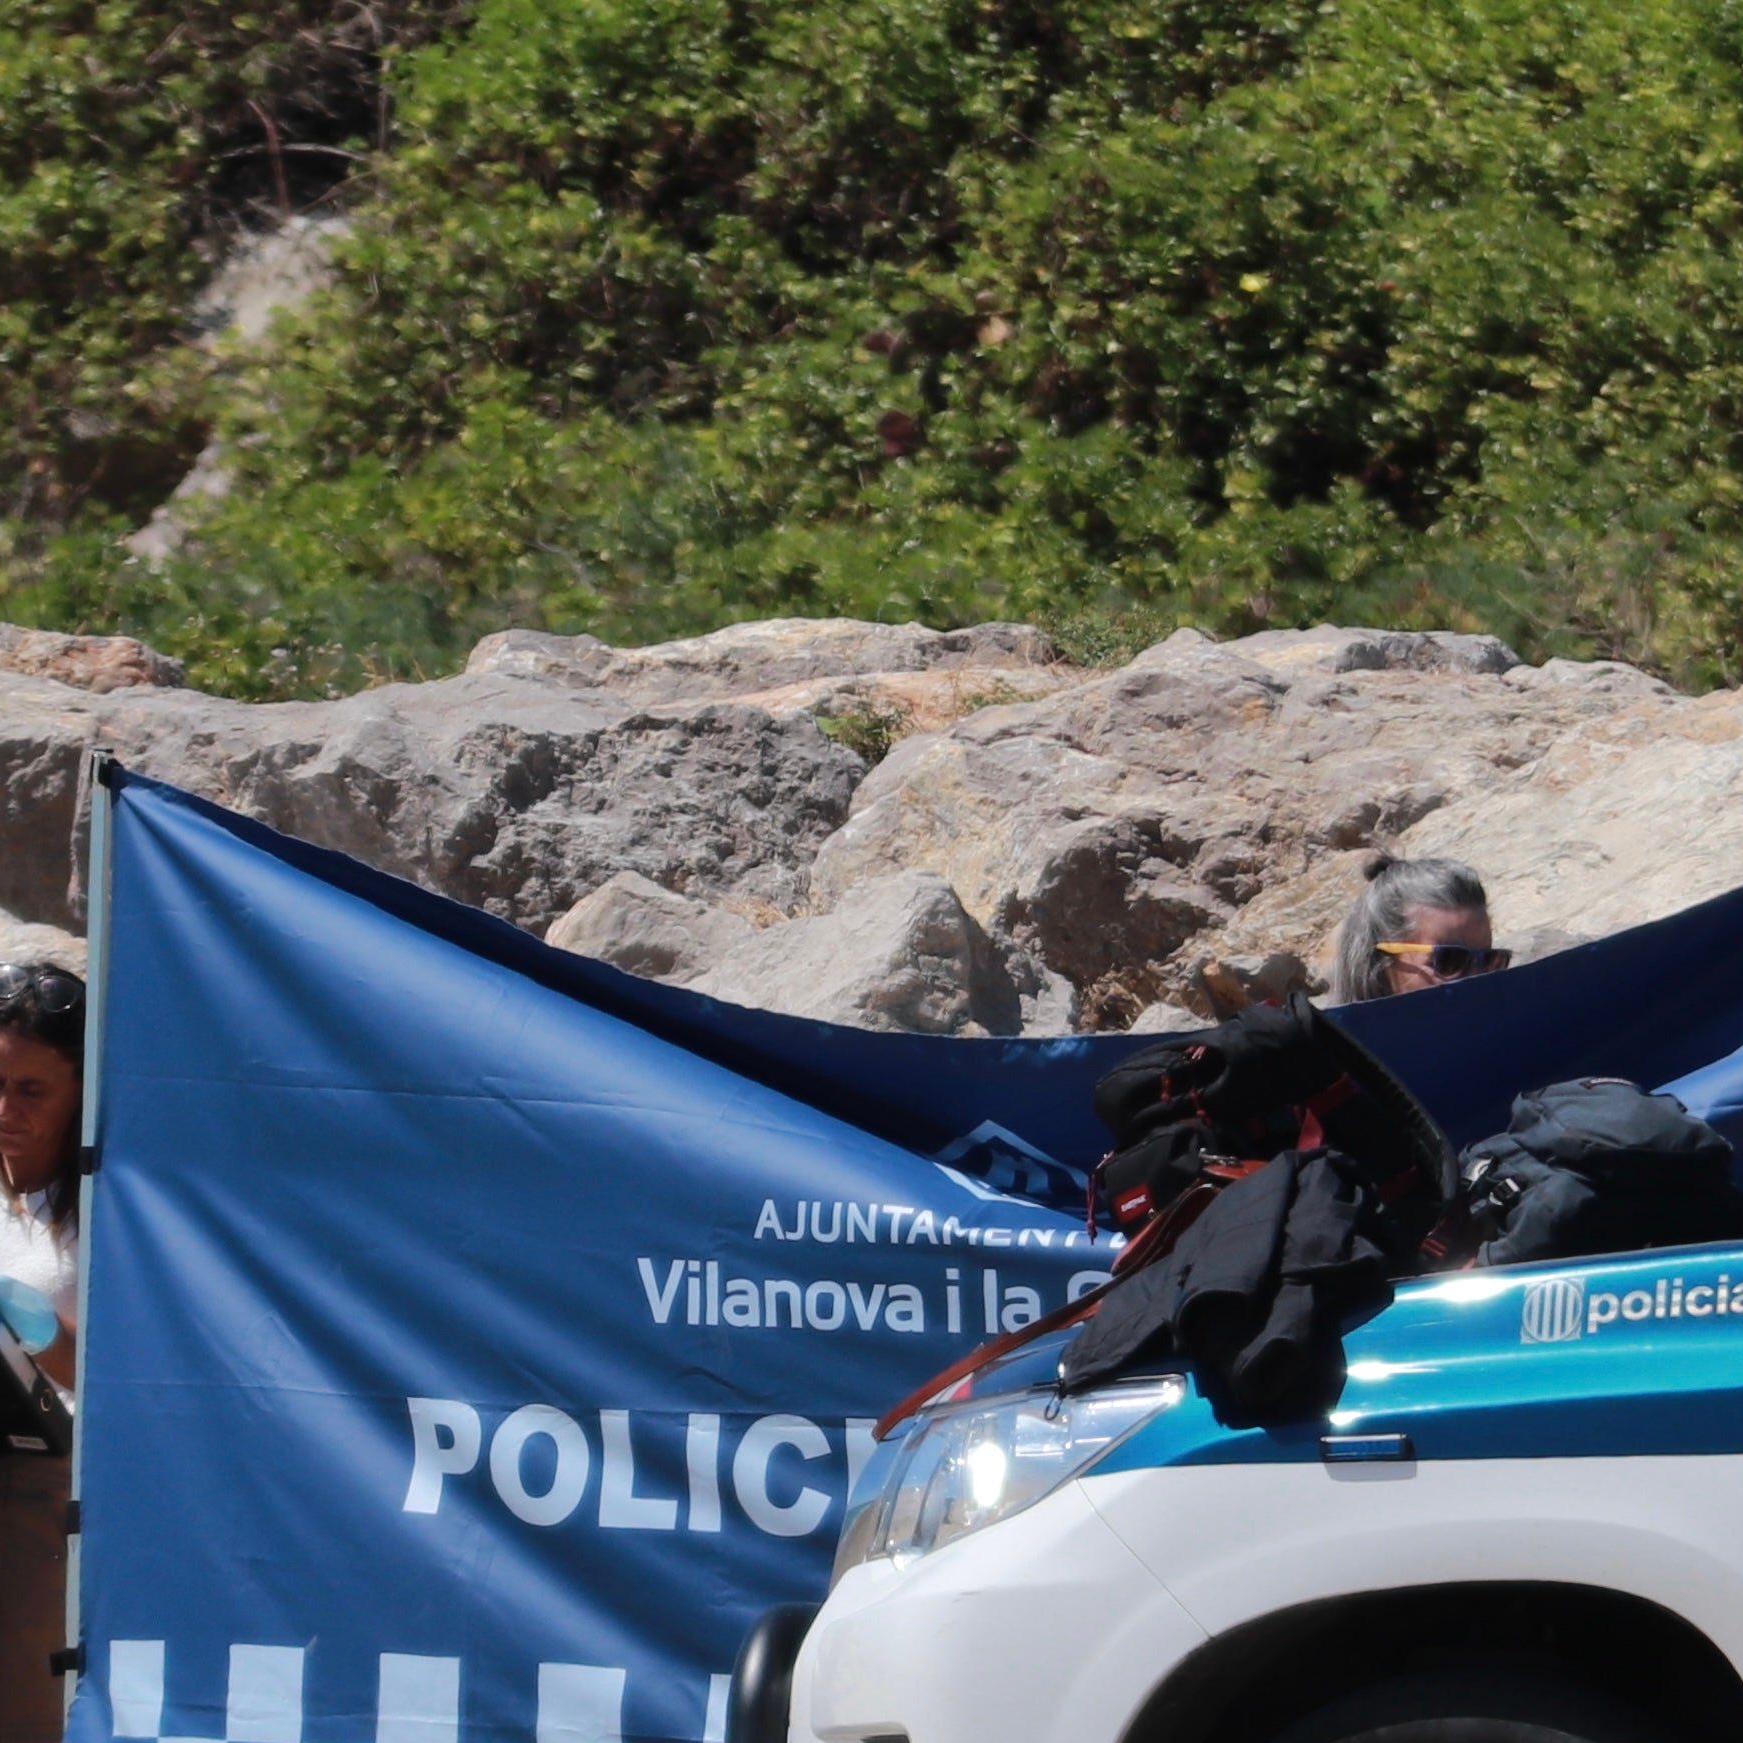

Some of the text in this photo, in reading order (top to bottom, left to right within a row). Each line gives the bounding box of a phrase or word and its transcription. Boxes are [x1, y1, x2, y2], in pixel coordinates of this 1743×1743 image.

[636, 1257, 925, 1333] Vilanova
[945, 1267, 961, 1333] i
[983, 1268, 1042, 1334] la
[402, 1397, 879, 1538] POLICI
